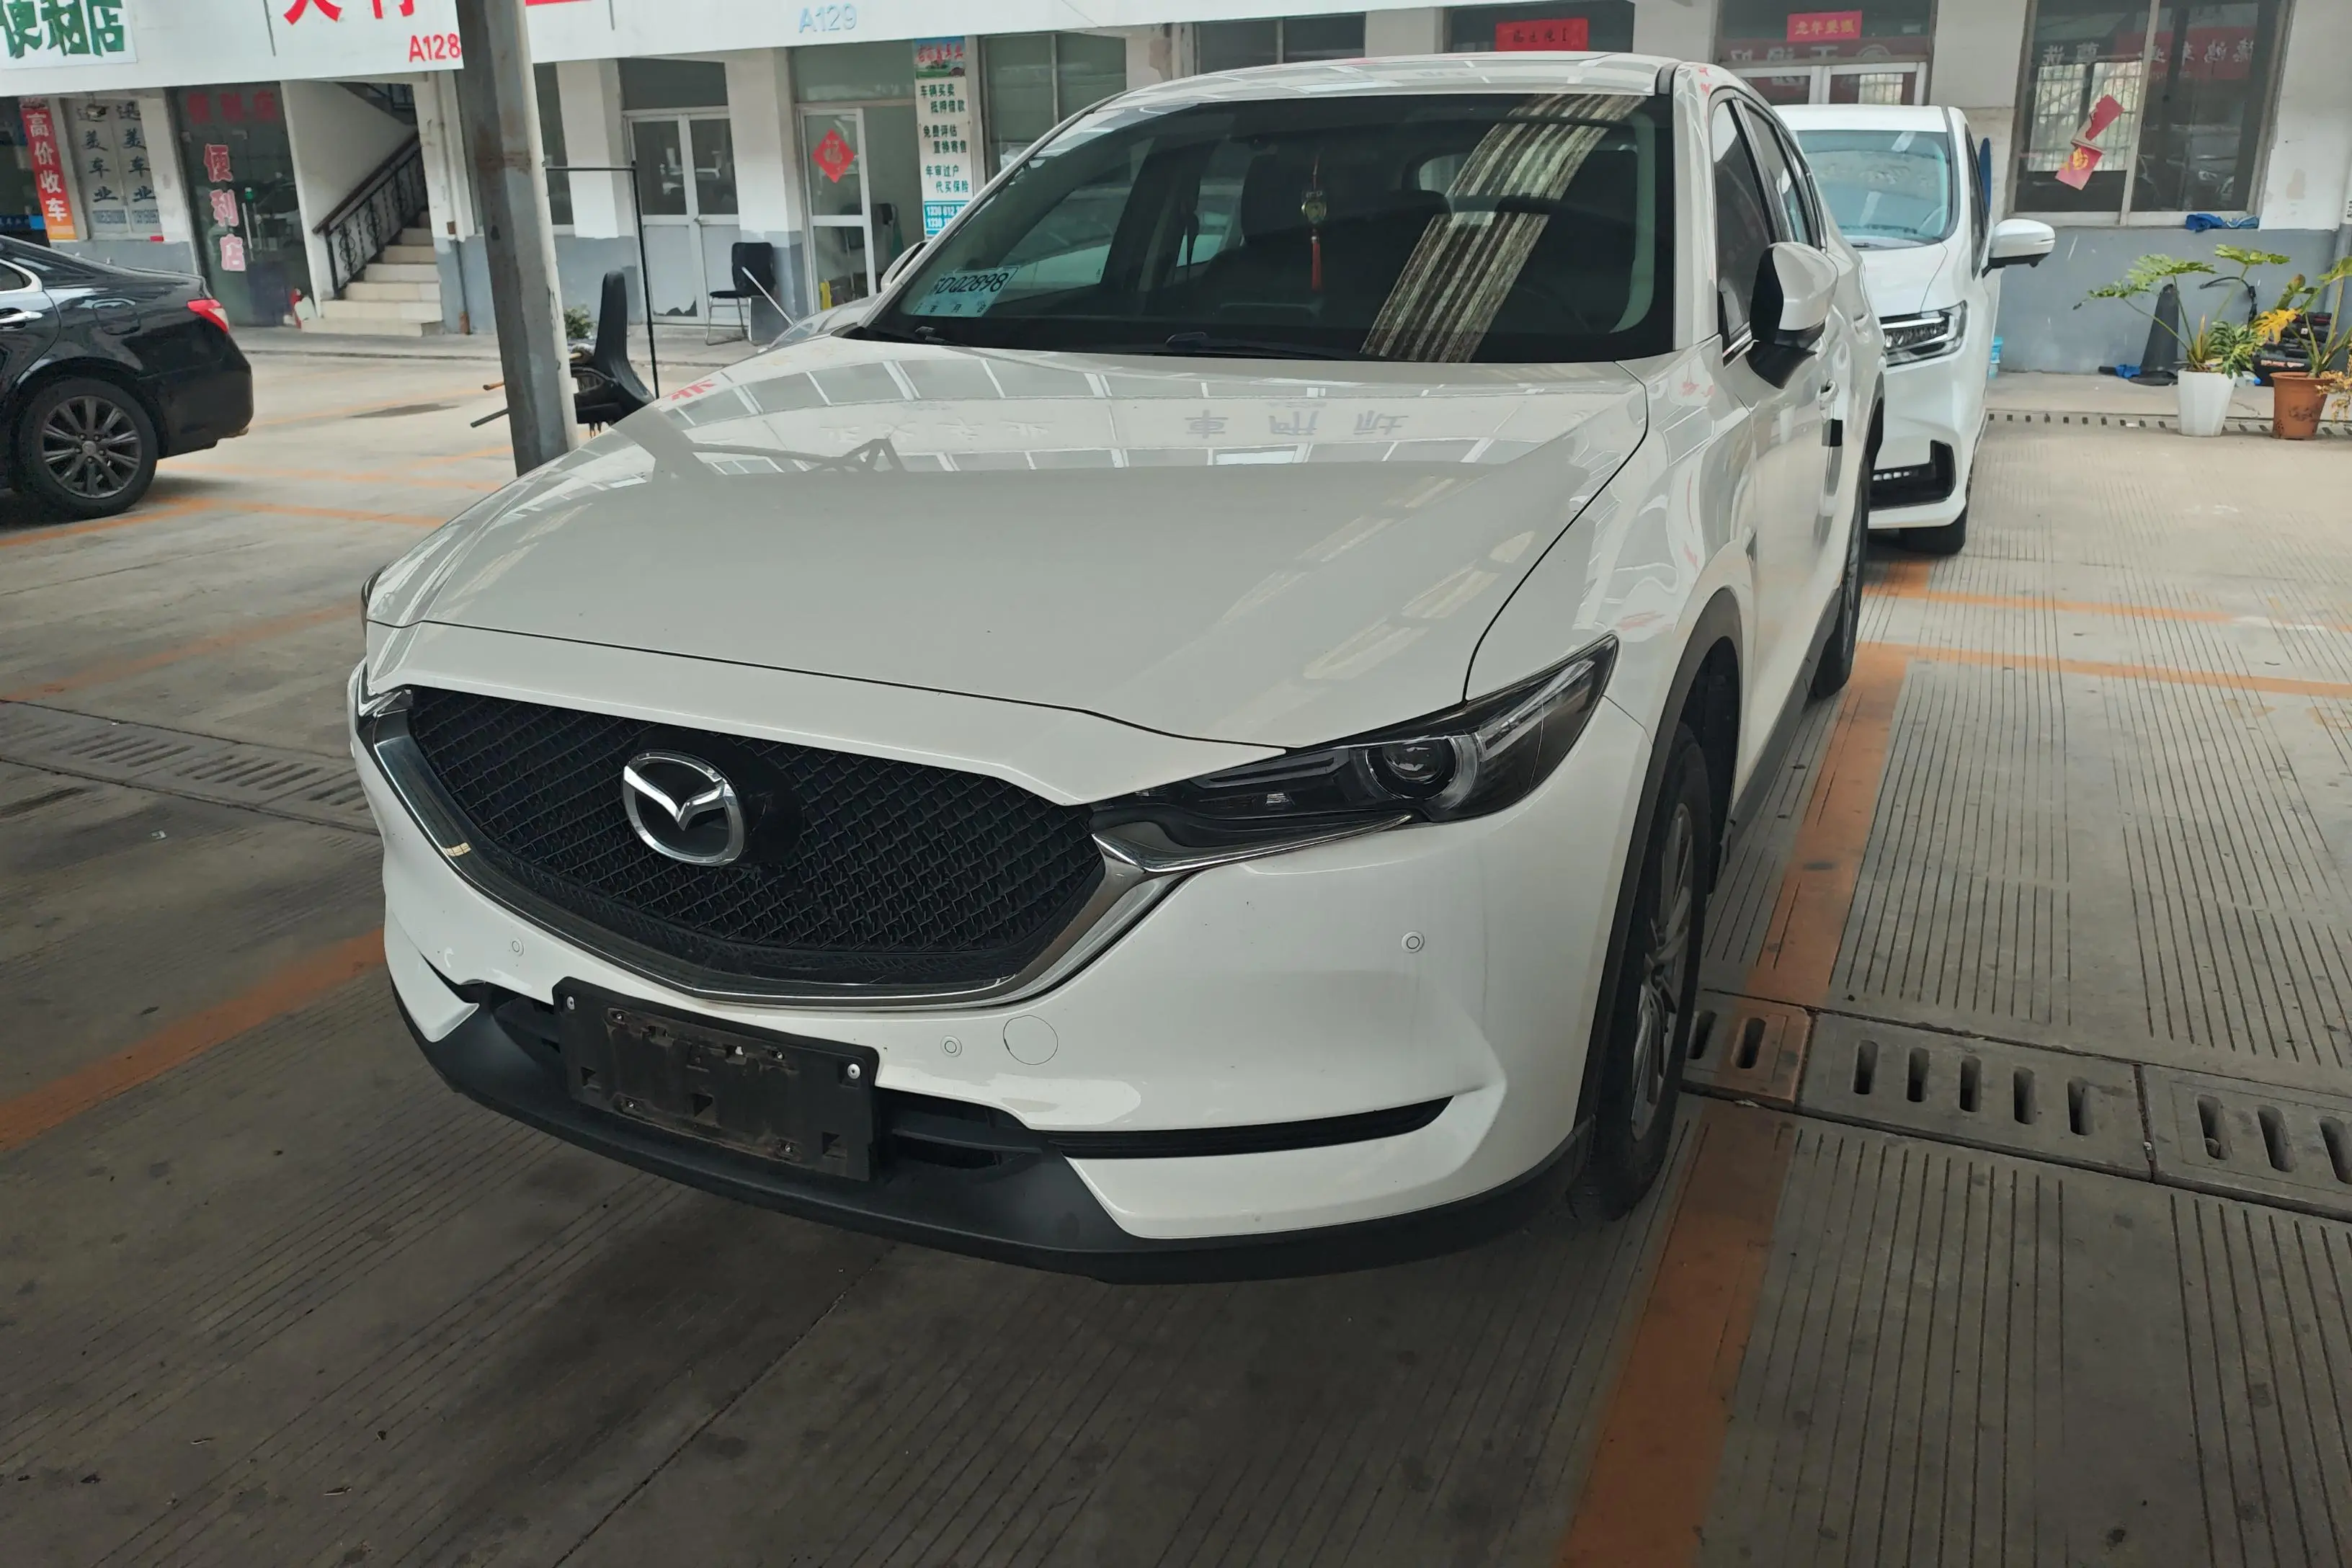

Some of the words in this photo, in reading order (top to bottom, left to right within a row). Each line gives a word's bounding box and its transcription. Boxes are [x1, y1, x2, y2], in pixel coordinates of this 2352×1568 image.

[798, 3, 858, 33] A129
[409, 33, 461, 63] A128
[920, 84, 955, 98] 车辆买卖
[922, 125, 958, 138] 免费评估
[26, 112, 68, 222] 高价收车
[925, 164, 959, 179] 年审过户
[935, 180, 969, 193] 代买保险
[203, 143, 246, 272] 便利店
